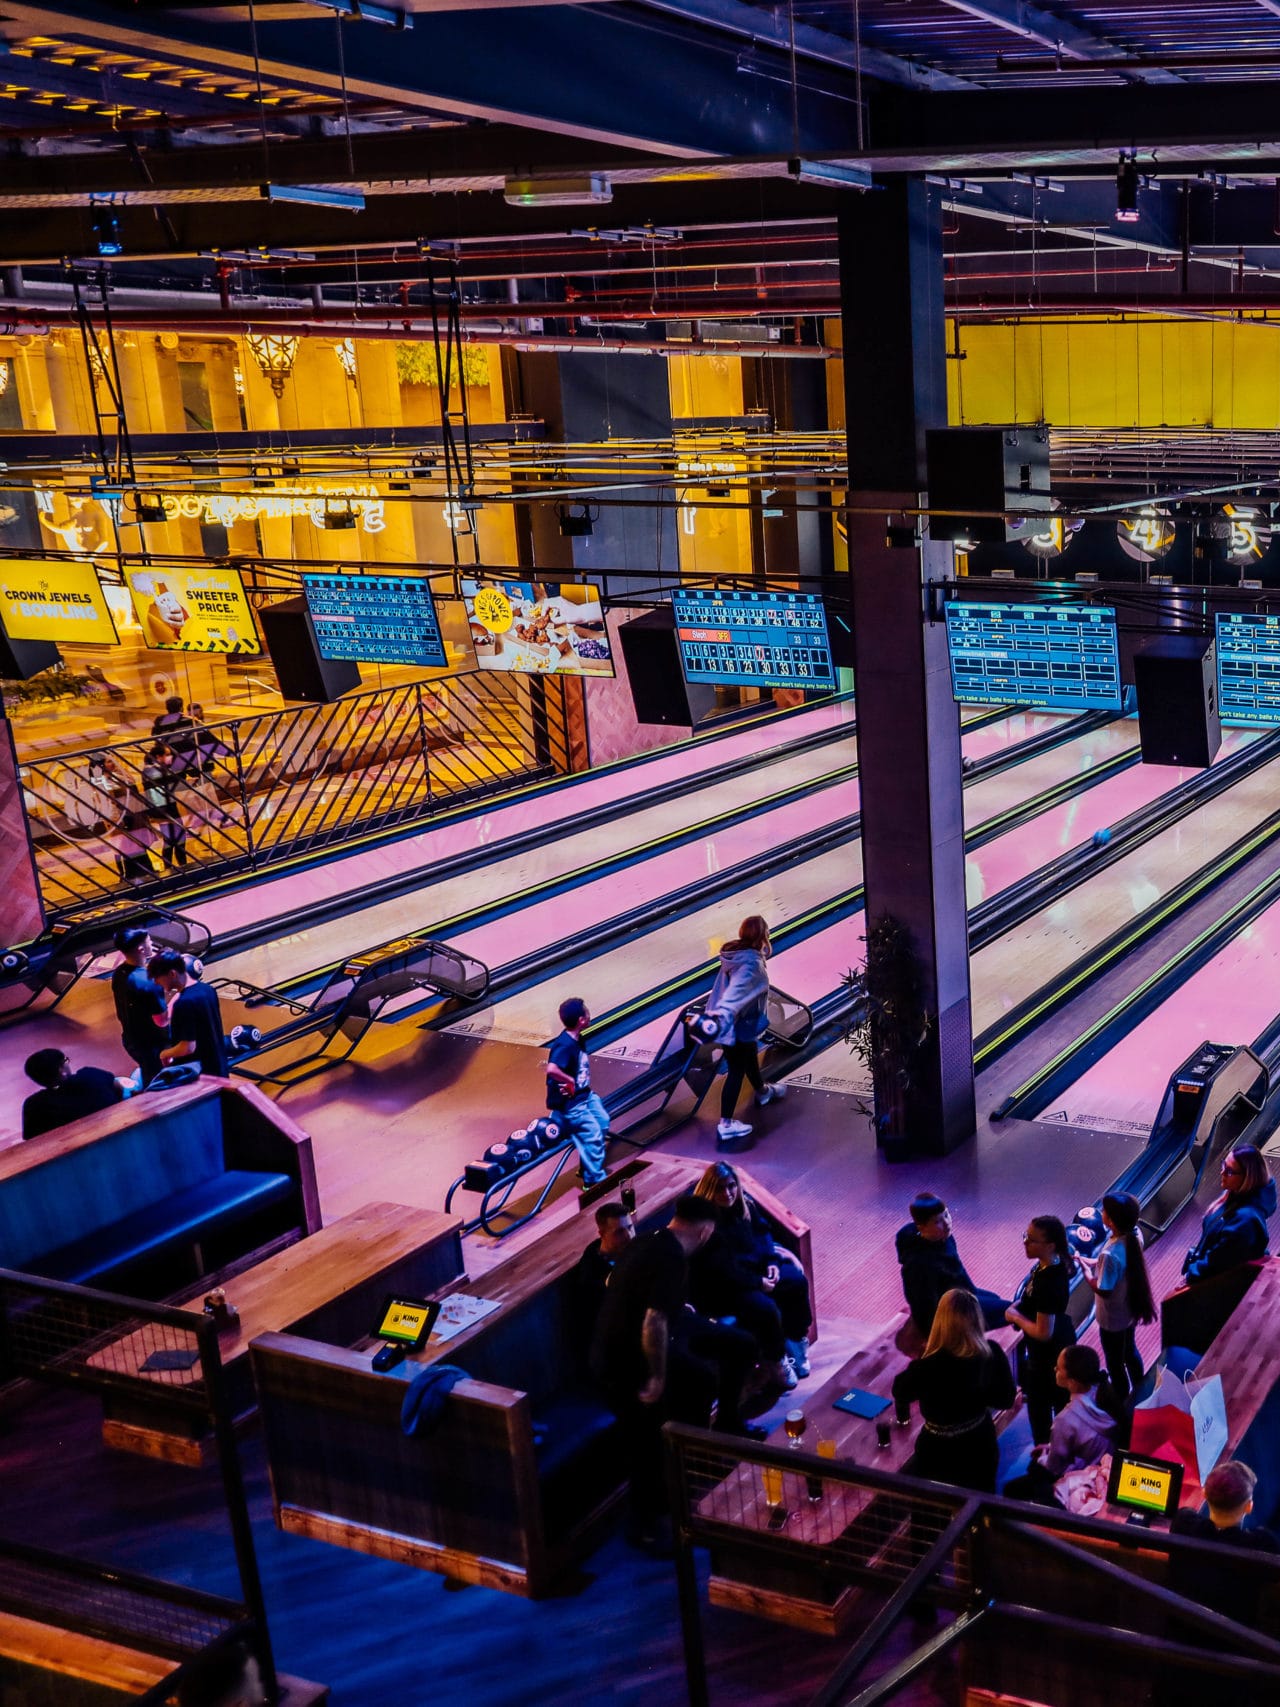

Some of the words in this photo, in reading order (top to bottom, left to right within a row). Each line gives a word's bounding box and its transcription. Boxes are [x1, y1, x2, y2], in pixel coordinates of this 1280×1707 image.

[1230, 512, 1256, 553] 5
[5, 590, 46, 602] CROWN
[49, 592, 92, 604] JEWELS
[186, 590, 239, 602] SWEETER
[20, 602, 98, 620] BOWLING
[198, 602, 234, 613] PRICE.
[402, 1314, 419, 1323] KING
[1141, 1476, 1162, 1489] KING
